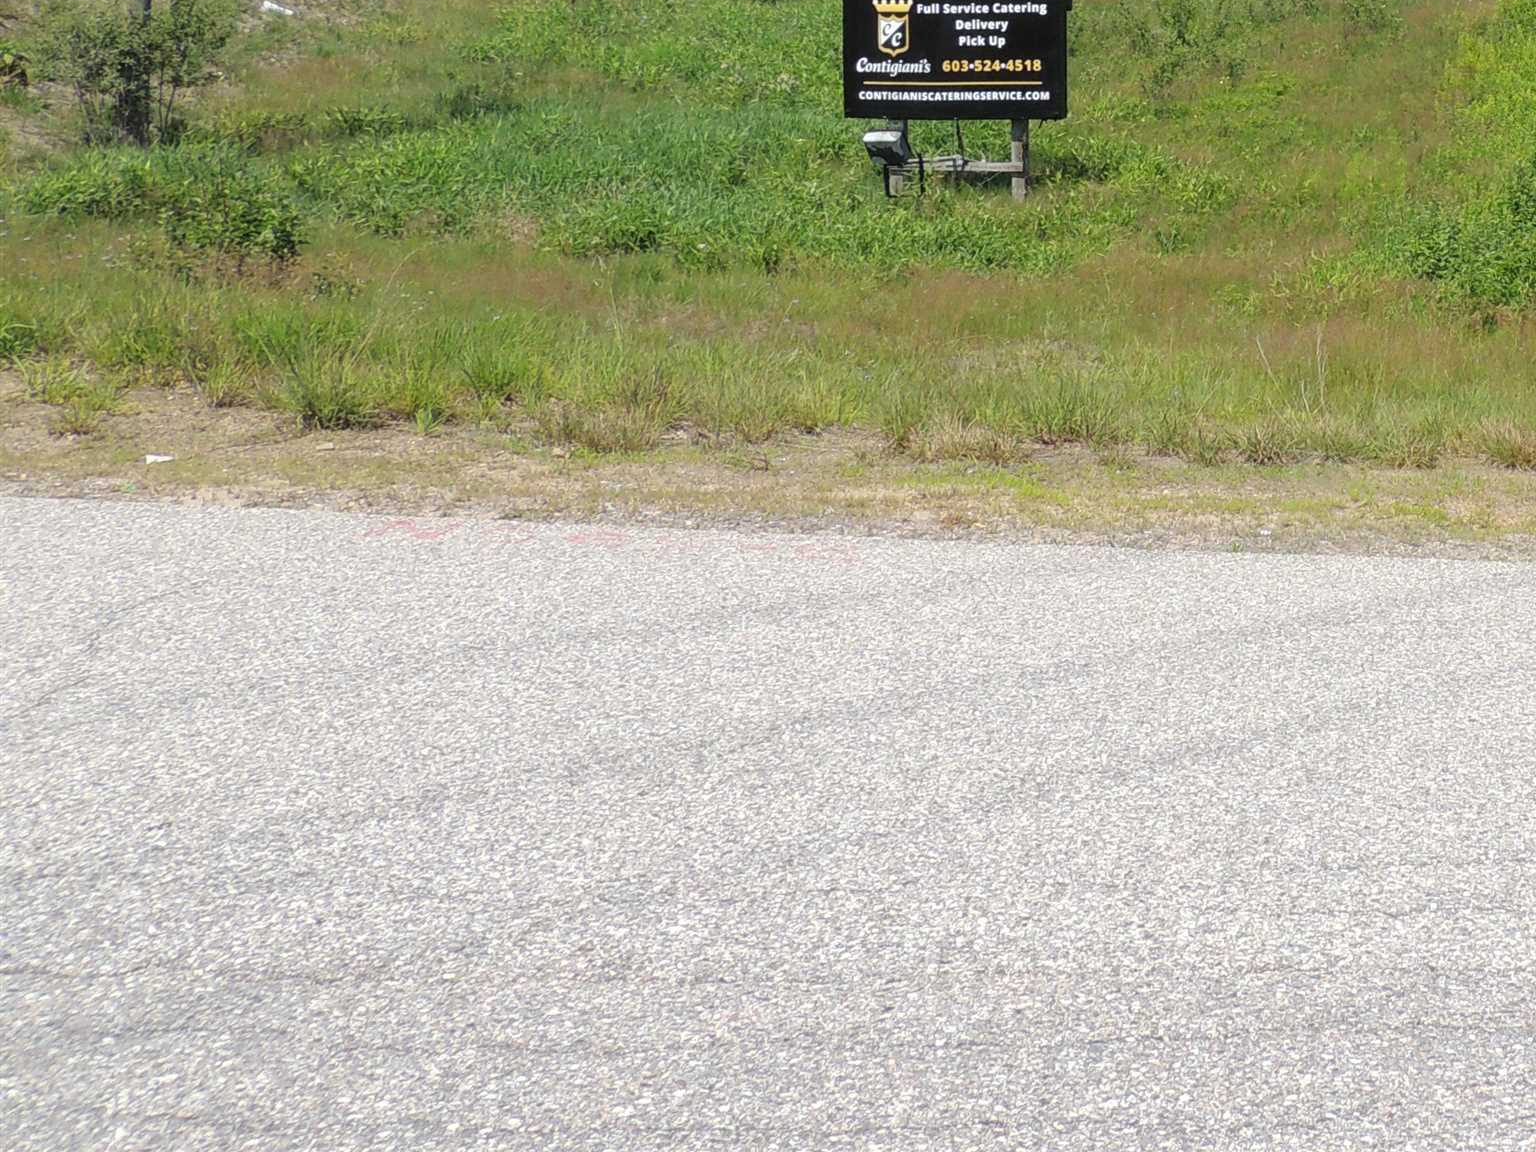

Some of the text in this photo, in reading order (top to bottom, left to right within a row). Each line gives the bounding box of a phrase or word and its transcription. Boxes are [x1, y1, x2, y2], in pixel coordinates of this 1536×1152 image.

[916, 2, 1048, 15] Full Service Catering
[955, 19, 1009, 32] Delivery
[958, 35, 1006, 48] Pick Up
[856, 57, 931, 77] Contigiani's
[858, 90, 1050, 101] CONTIGIANISCATERINGSERVICE.COM
